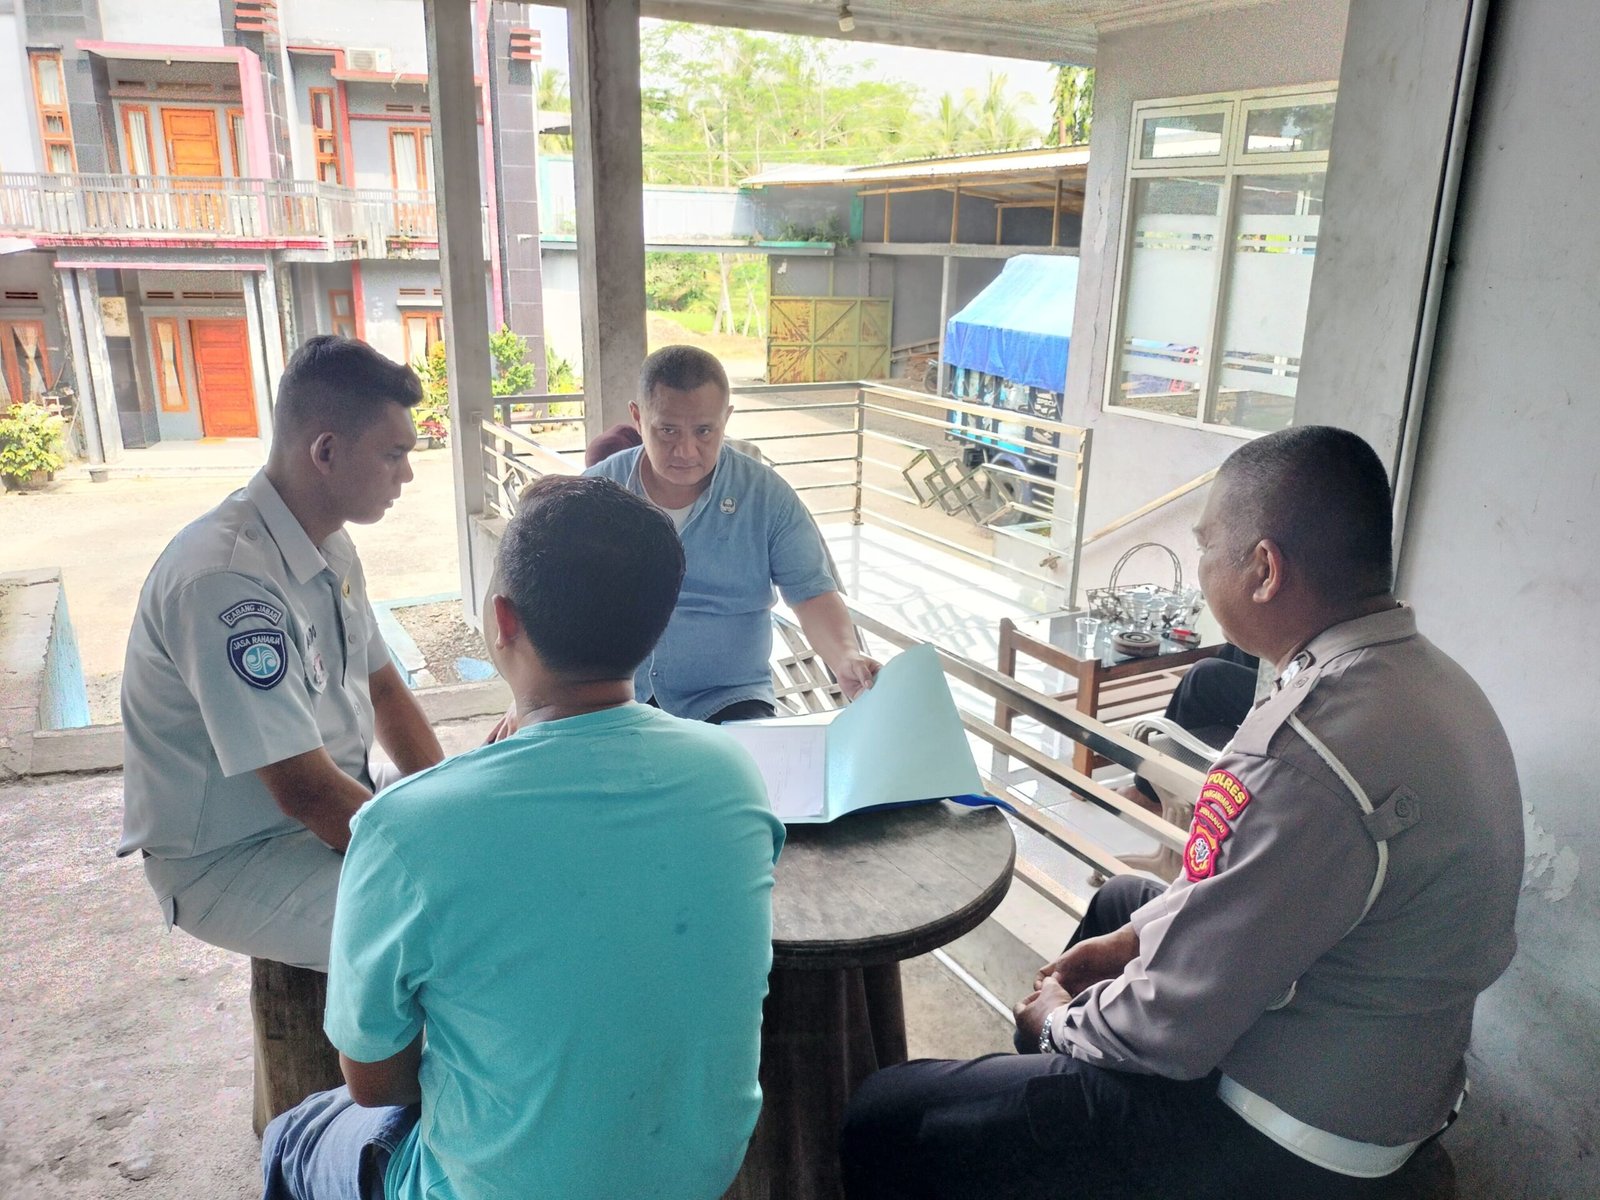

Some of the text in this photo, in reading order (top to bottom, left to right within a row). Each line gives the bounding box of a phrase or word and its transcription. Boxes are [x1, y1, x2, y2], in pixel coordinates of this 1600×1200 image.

[226, 604, 279, 622] CABANG JABAR
[233, 635, 281, 650] JASA RAHARJA
[1206, 773, 1246, 805] POLRES
